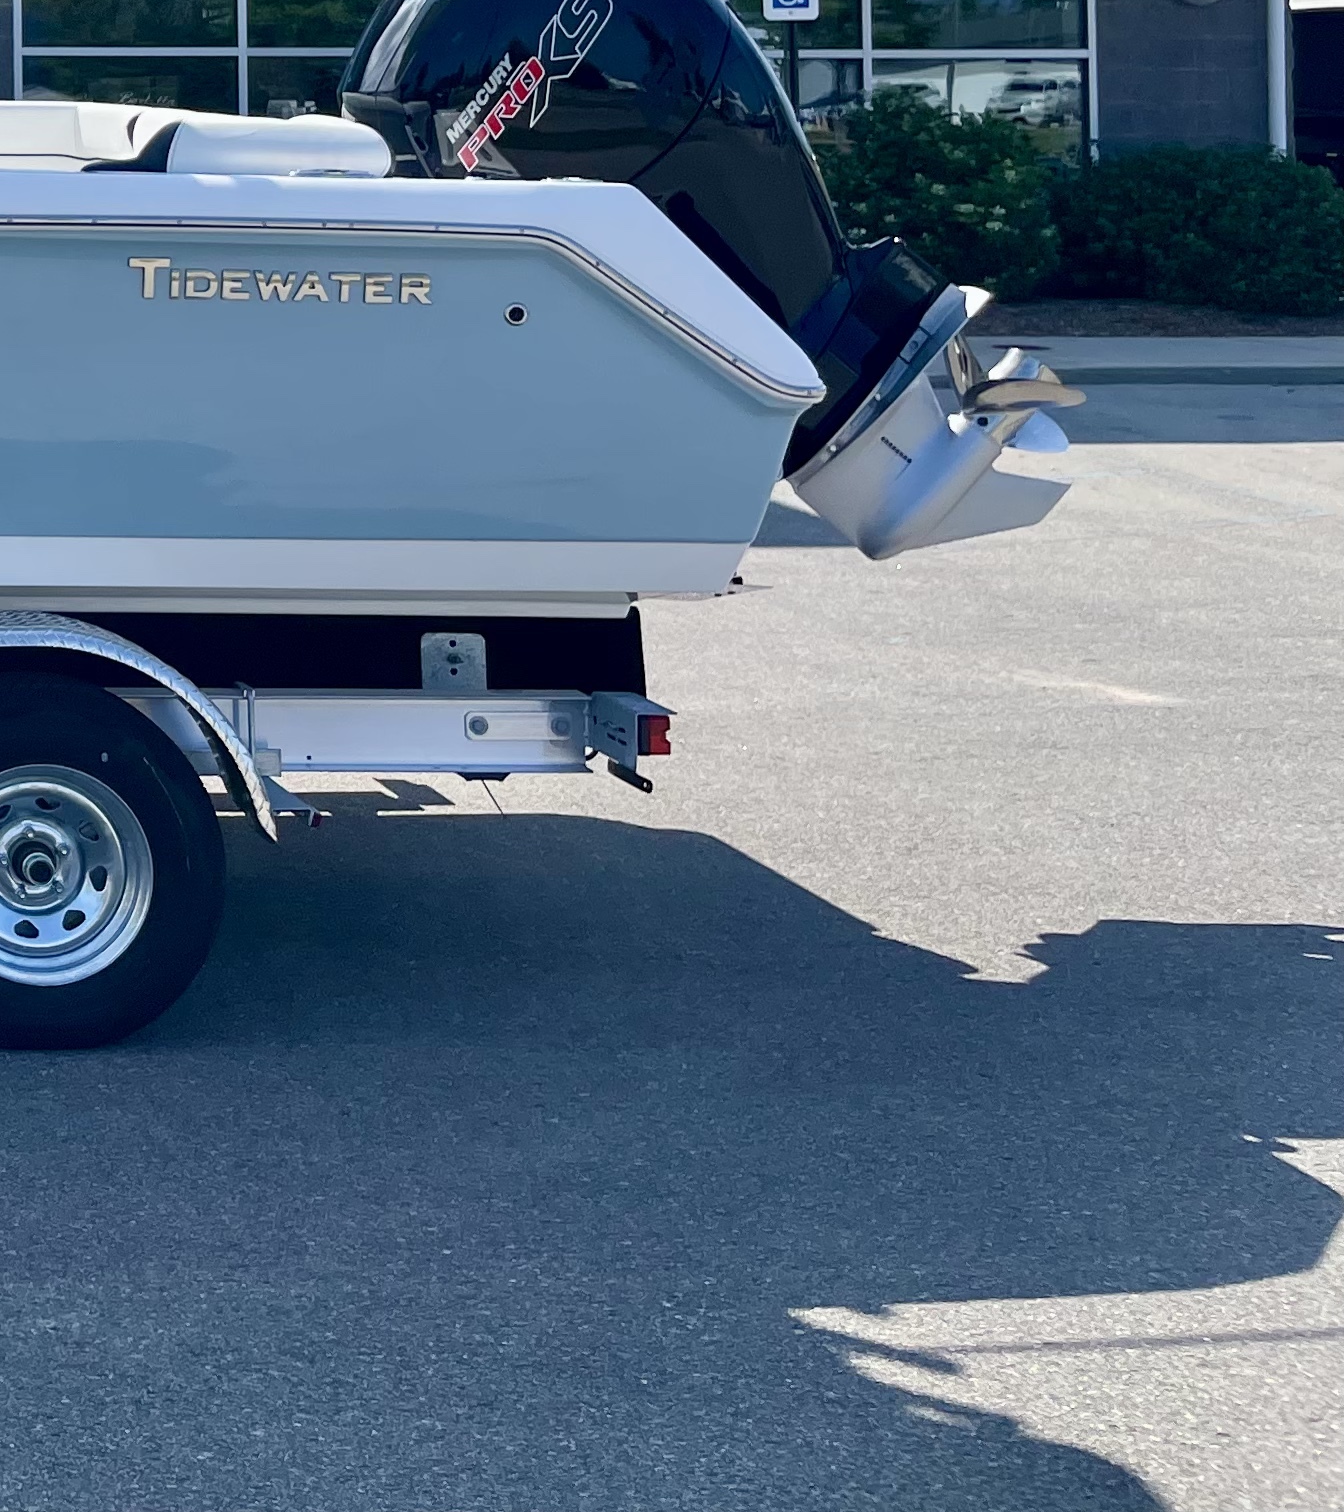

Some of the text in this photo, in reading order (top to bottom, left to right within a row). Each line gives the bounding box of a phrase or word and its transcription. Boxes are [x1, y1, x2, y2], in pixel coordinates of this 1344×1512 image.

[445, 52, 513, 145] MERCURY
[457, 56, 546, 173] PRO
[127, 257, 433, 305] TIDEWATER
